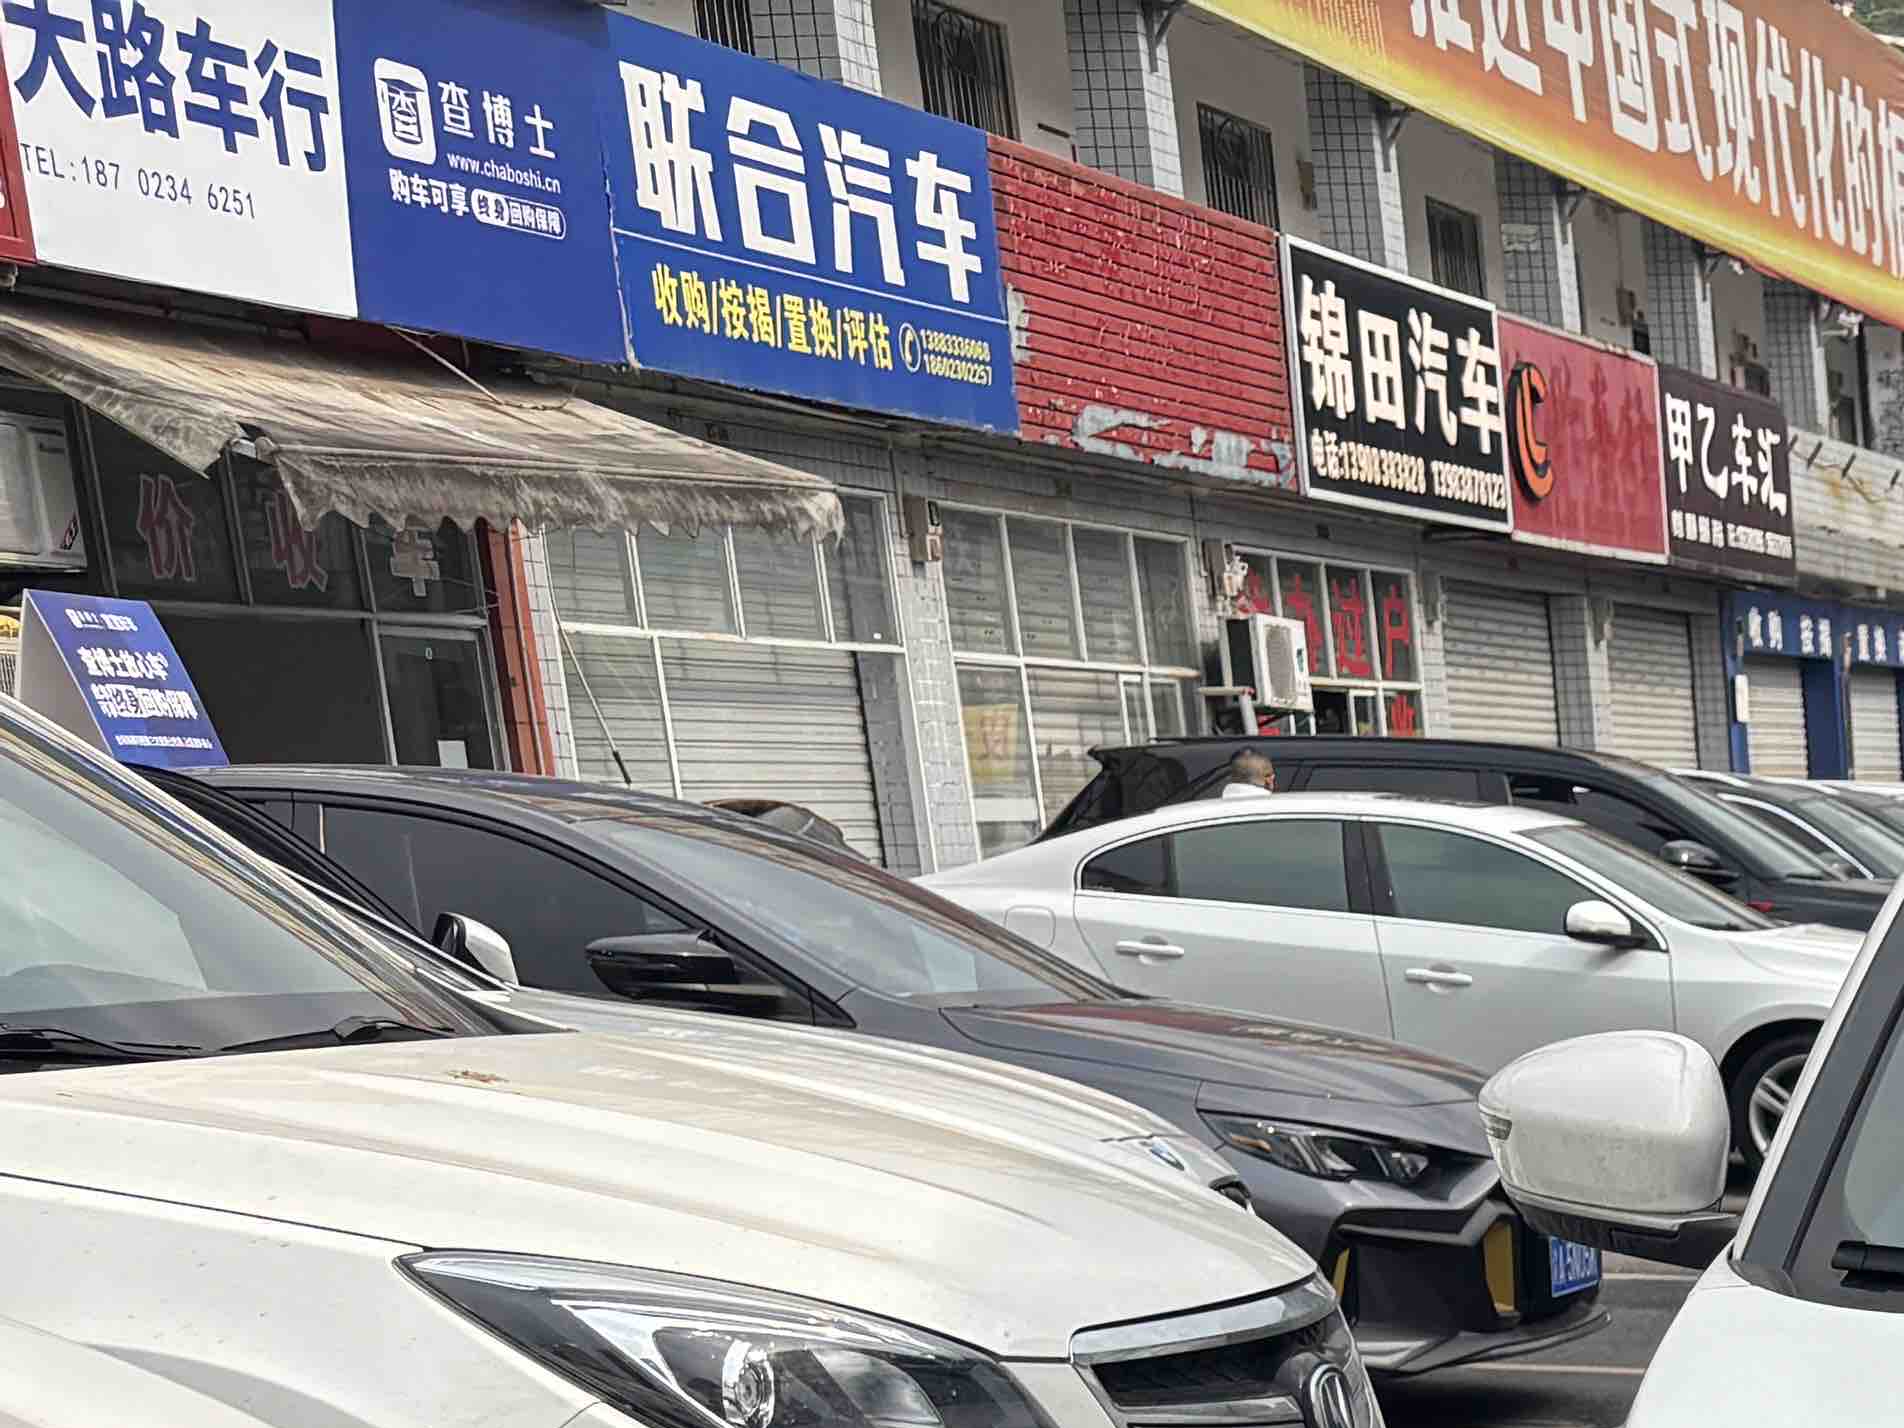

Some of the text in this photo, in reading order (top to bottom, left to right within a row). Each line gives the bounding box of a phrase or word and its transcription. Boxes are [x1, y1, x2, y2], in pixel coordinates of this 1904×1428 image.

[1, 0, 329, 172] 大路车行
[438, 80, 556, 160] 查博士
[137, 167, 193, 205] 0234
[206, 183, 256, 219] 6251
[447, 153, 561, 194] www.chaboshi.cn
[618, 60, 982, 304] 联合汽车
[651, 263, 893, 371] 收购/按揭/置换/评估
[1300, 274, 1503, 455] 锦田汽车
